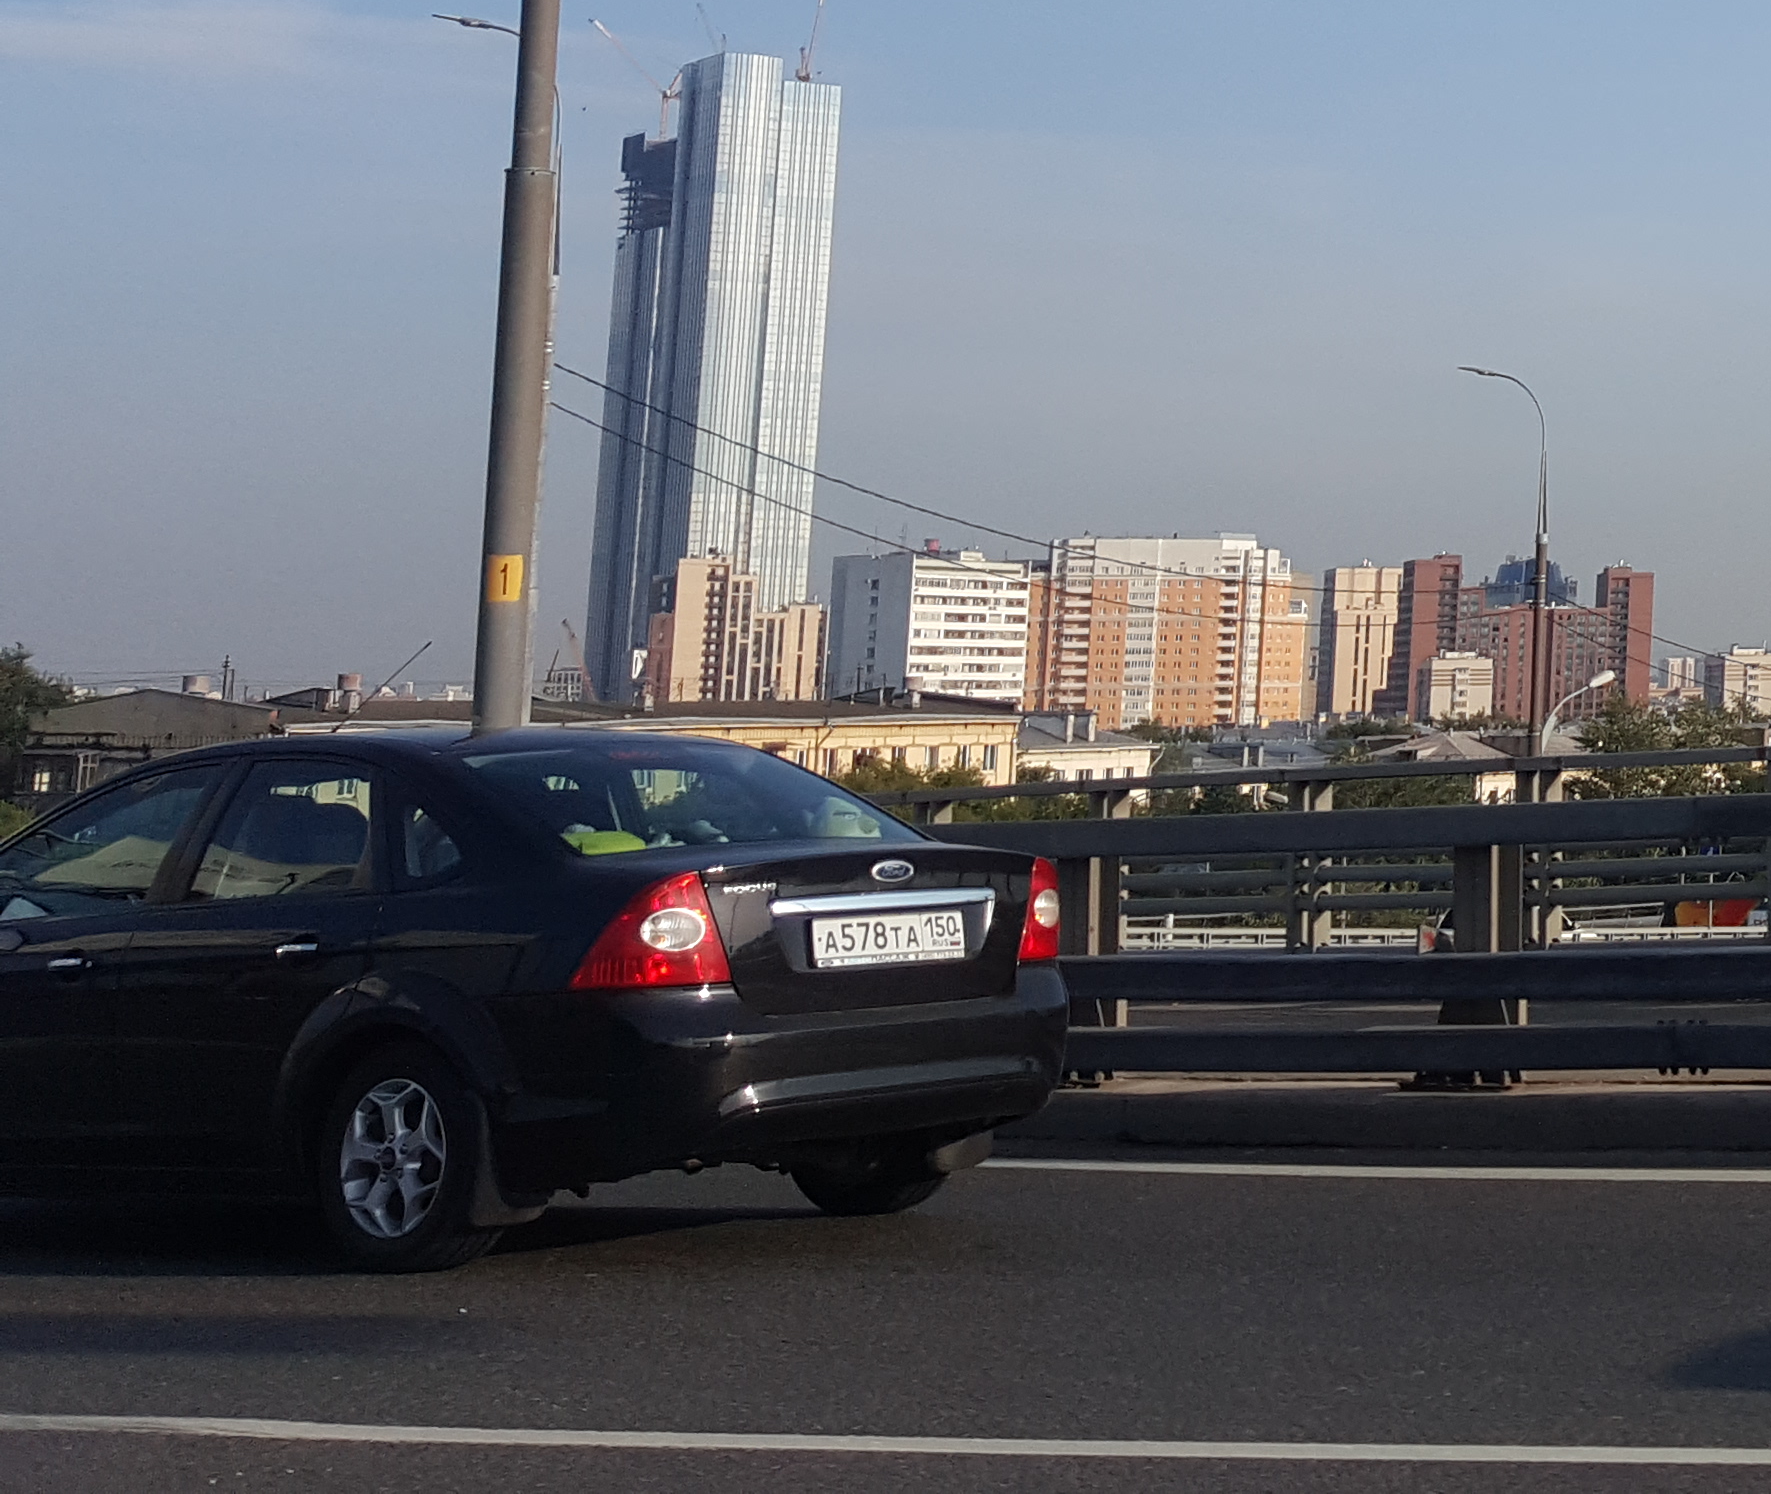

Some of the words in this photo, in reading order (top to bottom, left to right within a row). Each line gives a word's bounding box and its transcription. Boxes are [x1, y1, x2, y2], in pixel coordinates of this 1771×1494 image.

[500, 562, 508, 596] 1
[924, 915, 957, 938] 150
[932, 938, 949, 947] RUS
